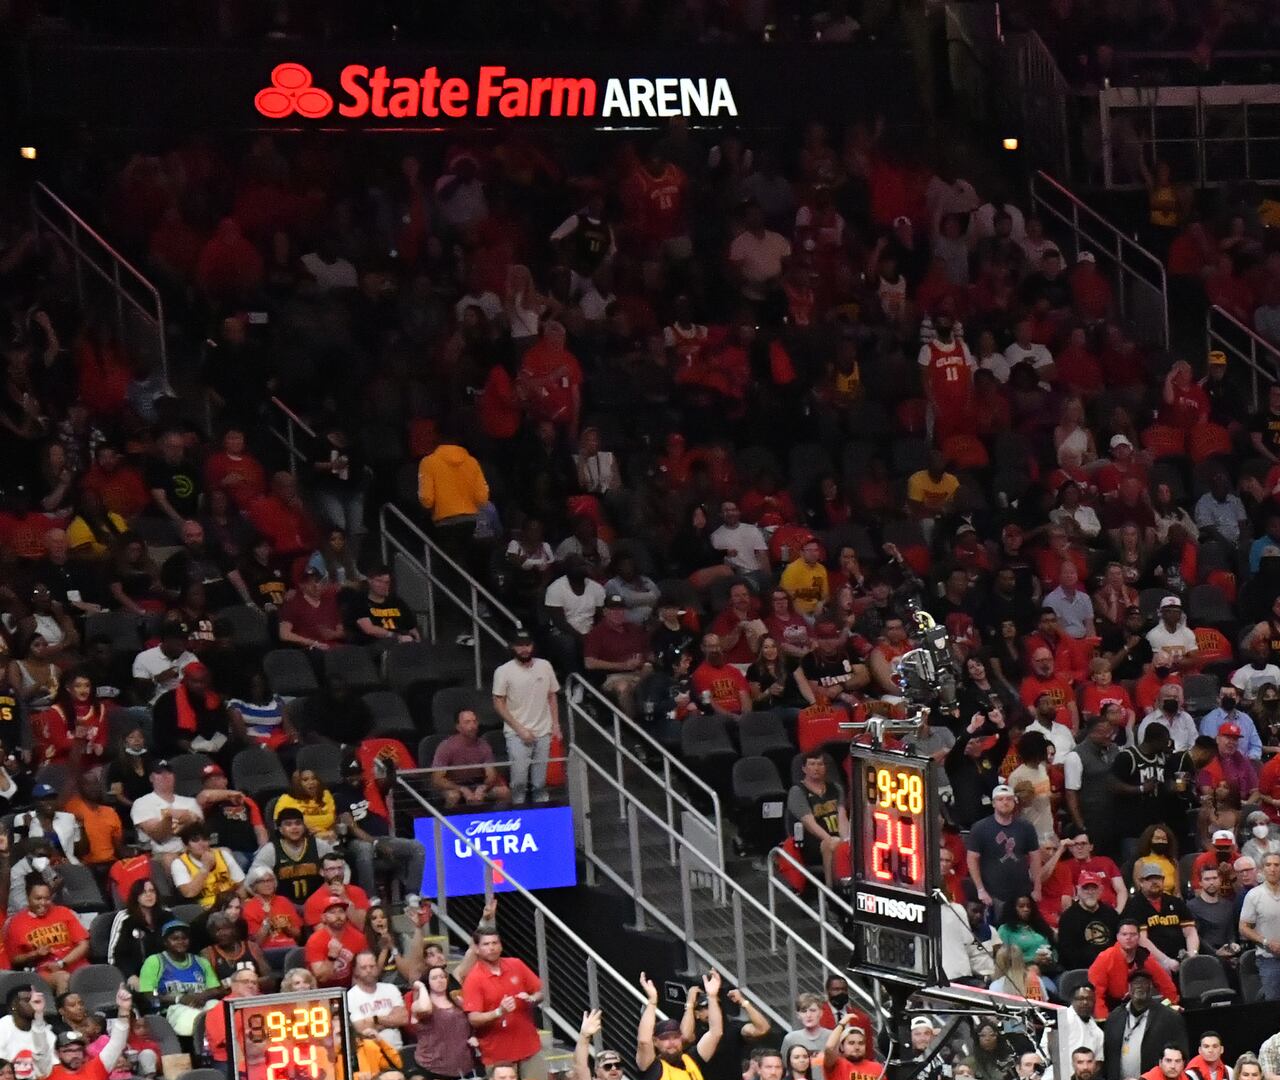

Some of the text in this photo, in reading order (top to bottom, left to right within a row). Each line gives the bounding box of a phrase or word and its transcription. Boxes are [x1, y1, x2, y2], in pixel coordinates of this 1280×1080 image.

[338, 64, 738, 118] State Farm ARENA
[945, 366, 959, 381] 11
[876, 768, 923, 814] 9:28
[465, 816, 522, 837] Michelob
[454, 832, 538, 859] ULTRA
[872, 811, 917, 881] 24
[292, 880, 309, 899] 11
[875, 899, 926, 924] TISSOT
[265, 1006, 330, 1043] 9:28
